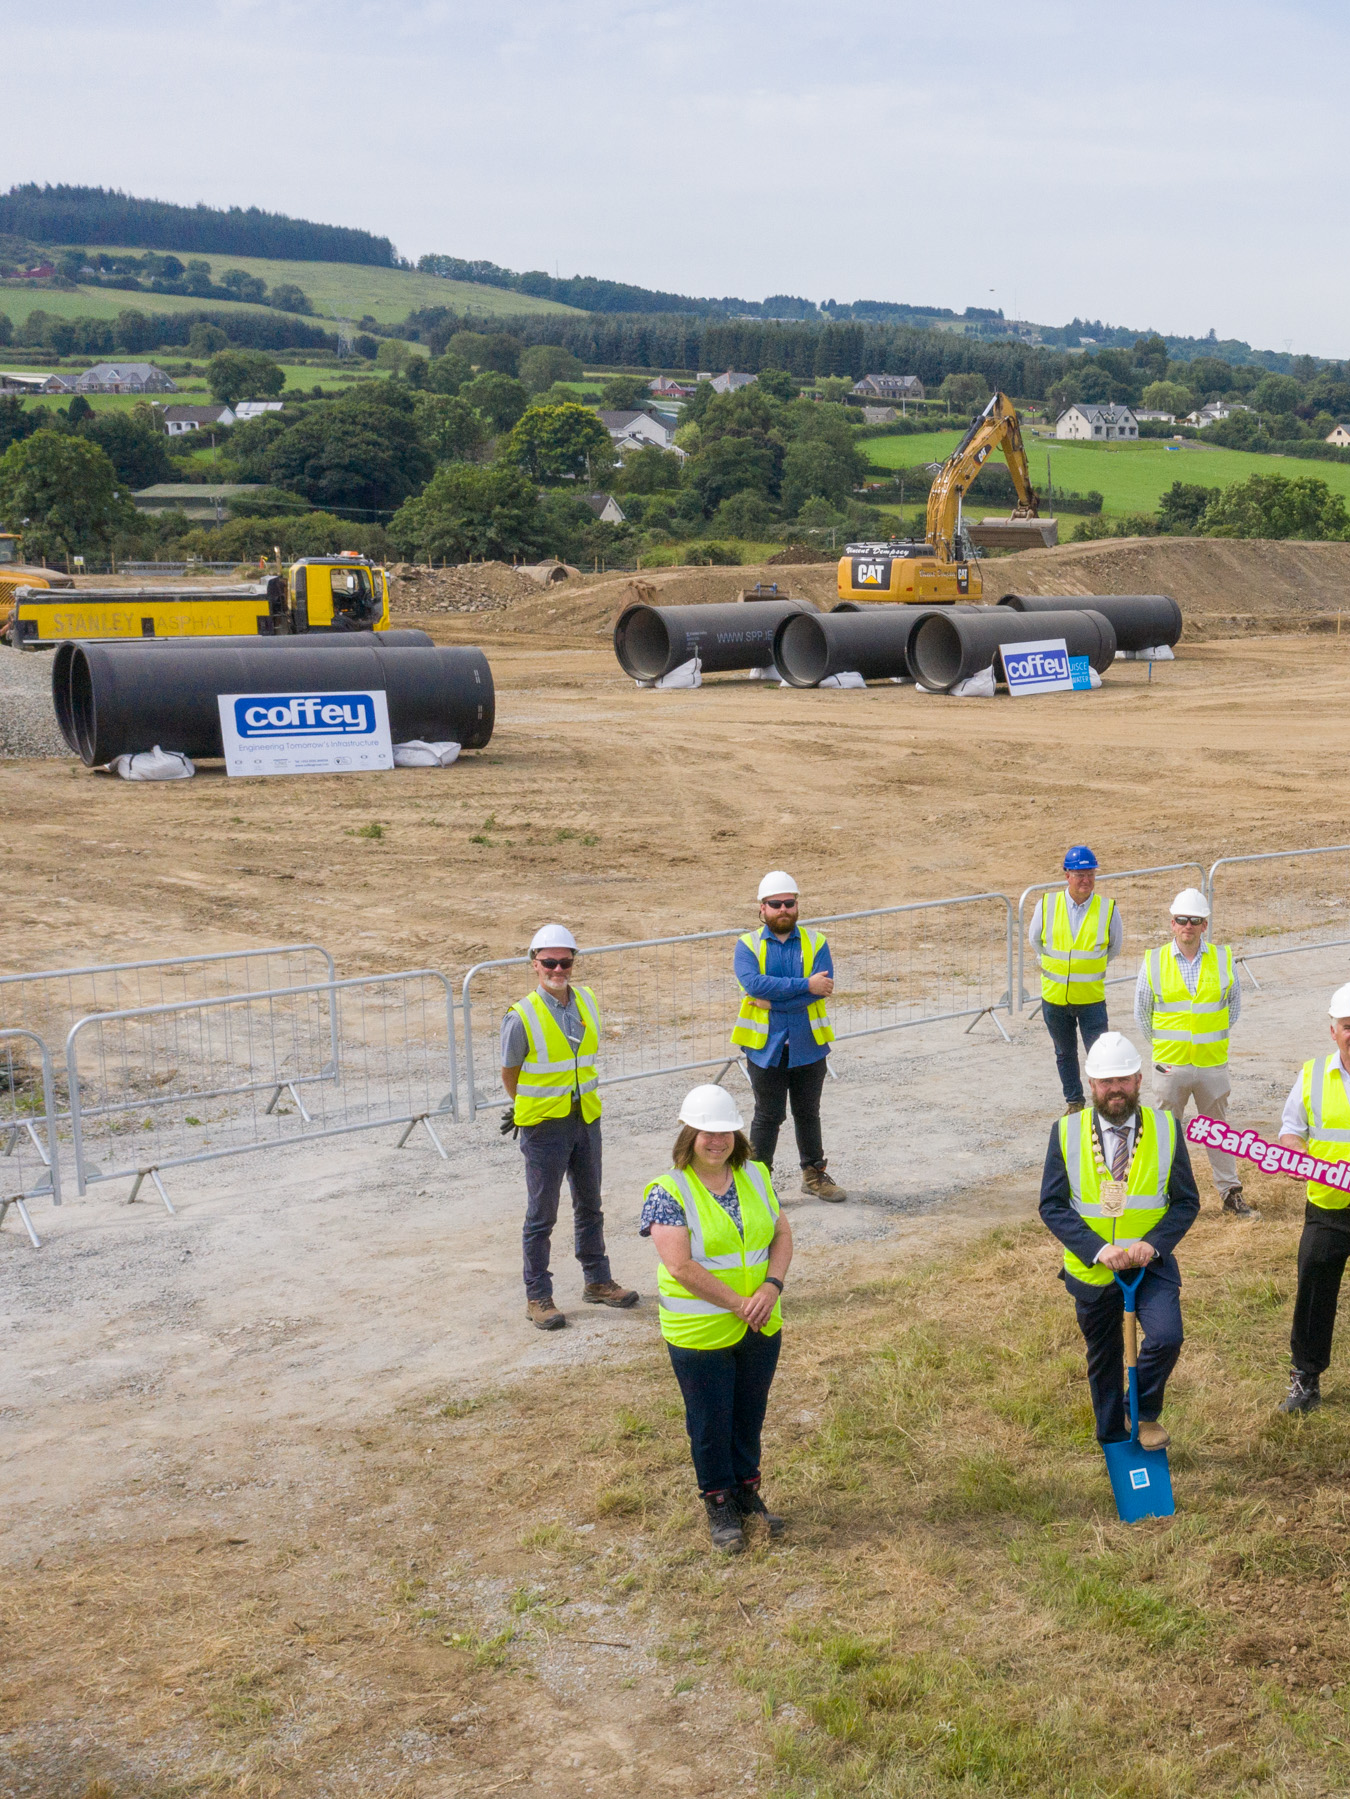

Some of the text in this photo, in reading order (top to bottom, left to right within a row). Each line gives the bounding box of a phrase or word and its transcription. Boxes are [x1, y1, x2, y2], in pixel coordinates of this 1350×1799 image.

[872, 547, 910, 556] Dempsey
[857, 564, 884, 584] CAT
[957, 568, 968, 580] CAT
[53, 613, 235, 634] STANLEY ASPHALT
[716, 629, 774, 643] WWW.SPP.IE
[1007, 654, 1068, 679] coffey
[245, 698, 368, 732] coffey
[238, 739, 380, 753] Engineering Tomorrow's Infrastructure
